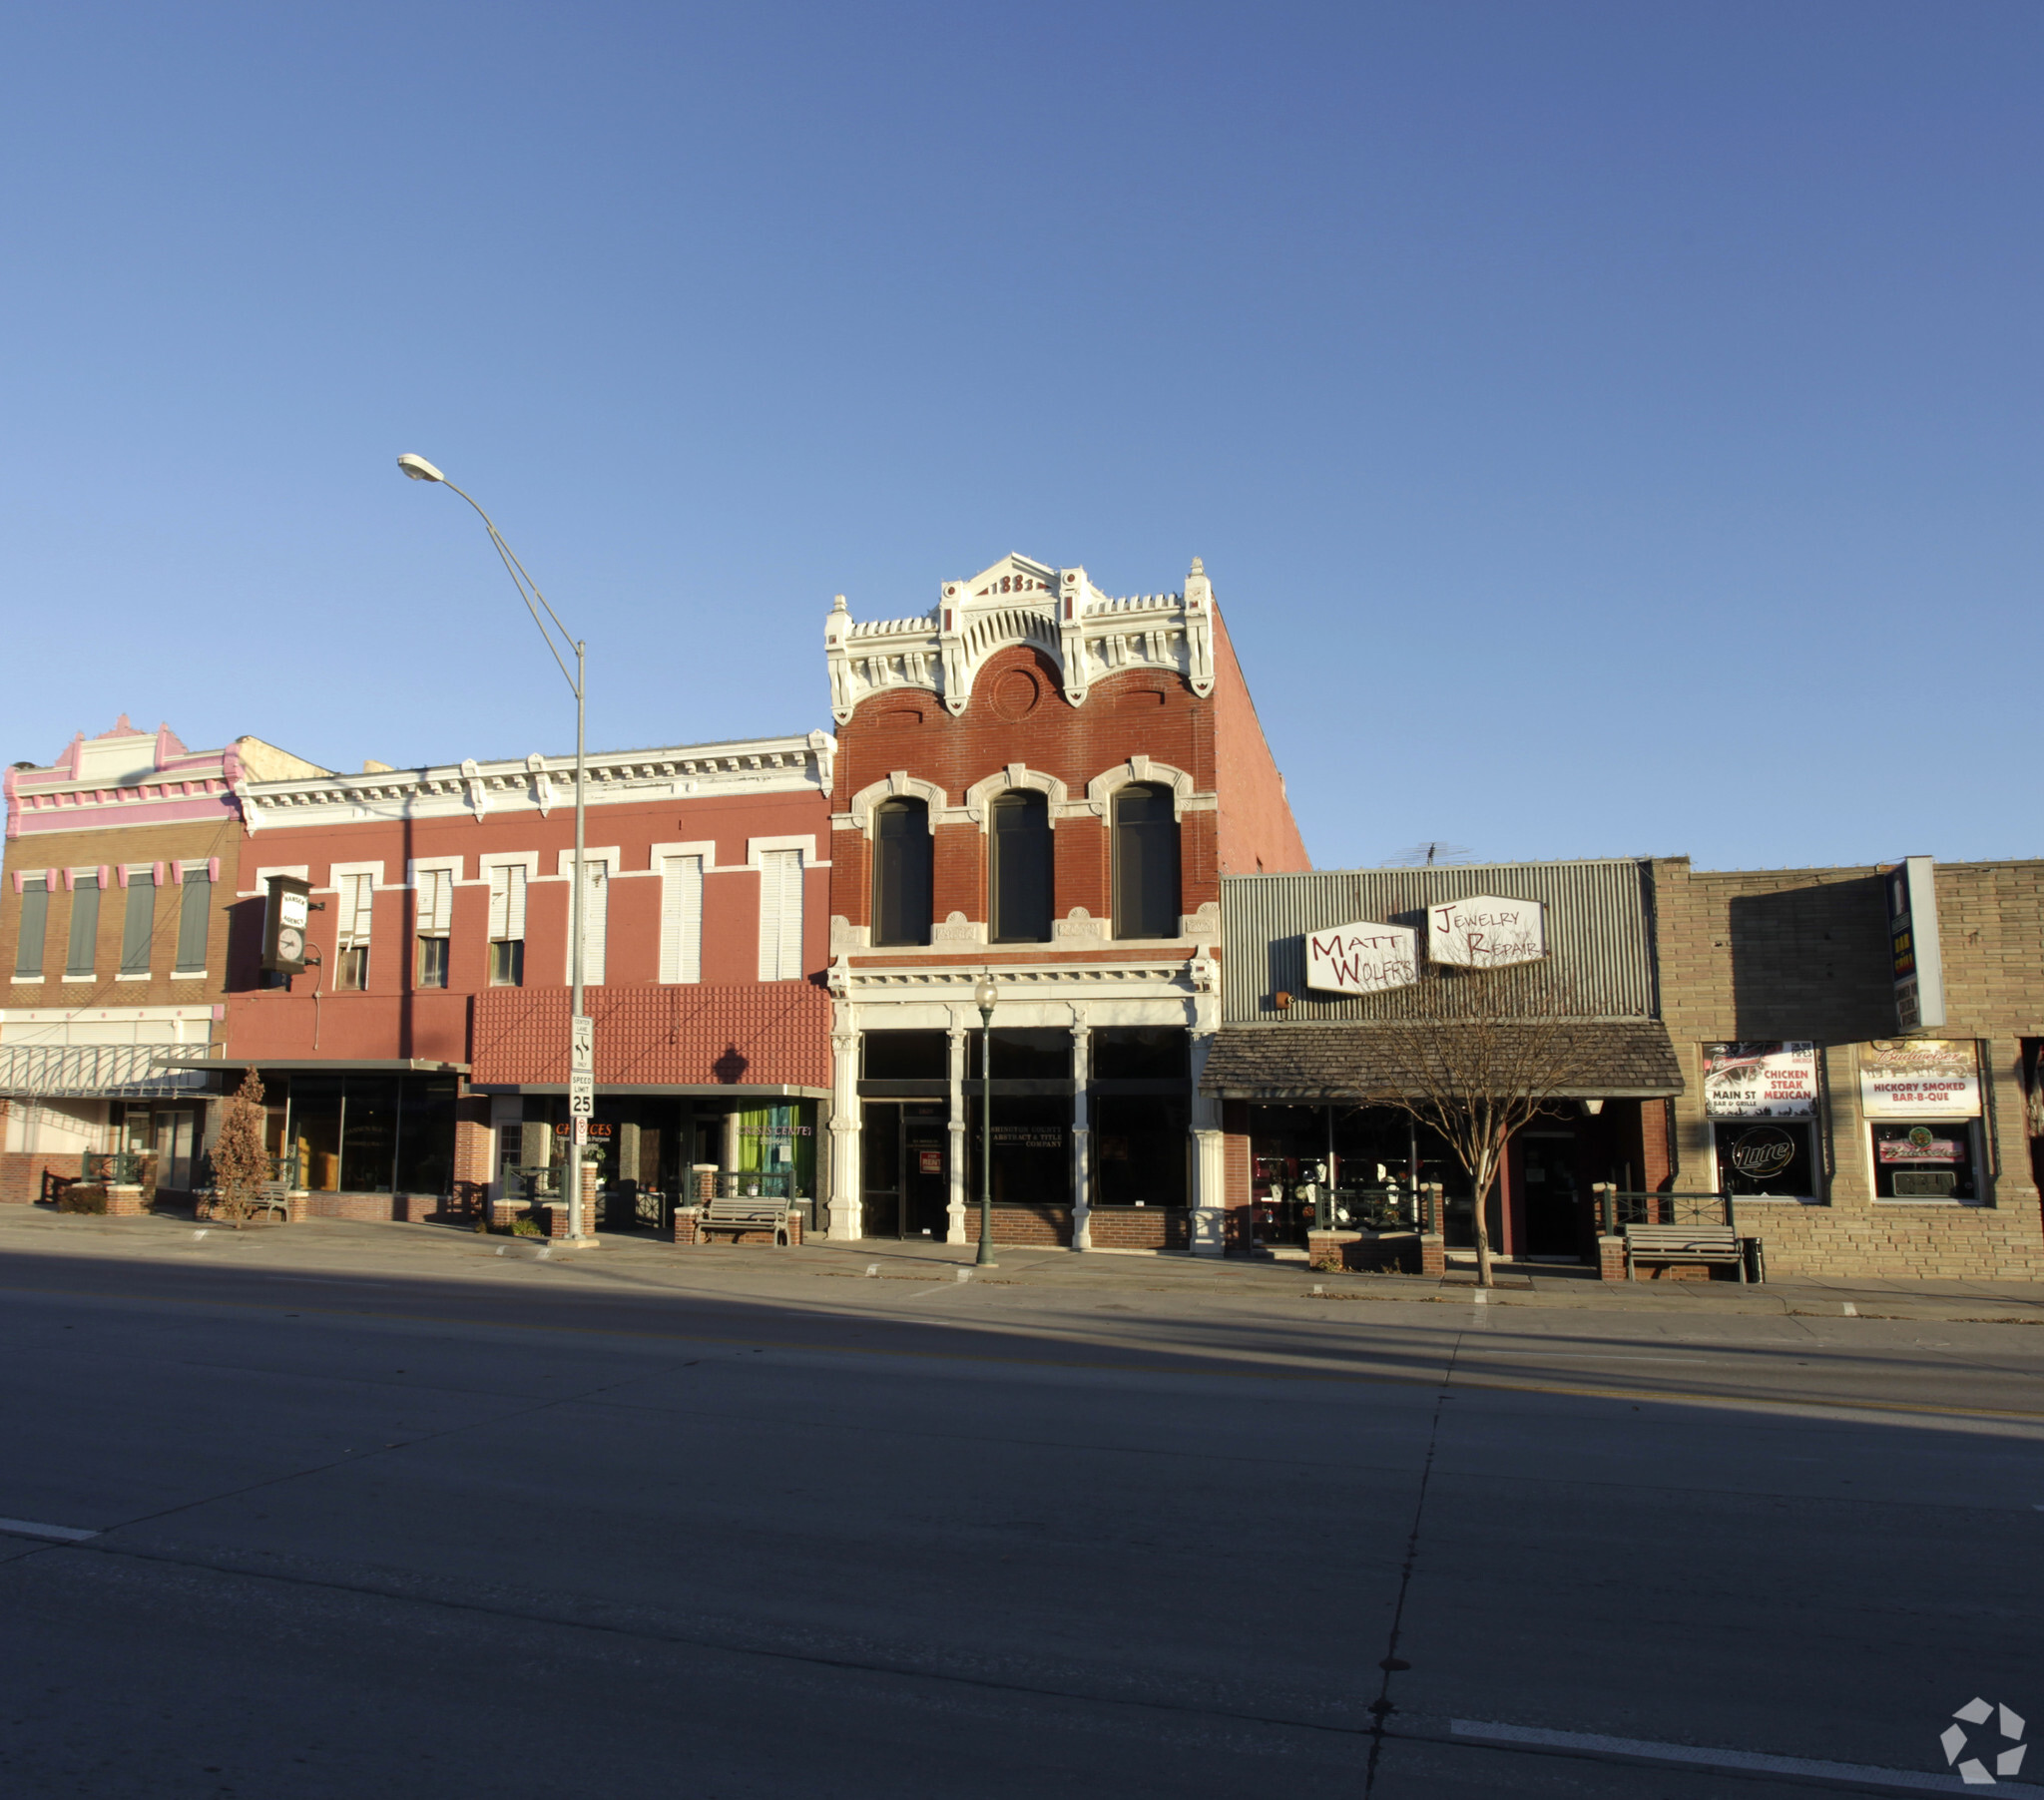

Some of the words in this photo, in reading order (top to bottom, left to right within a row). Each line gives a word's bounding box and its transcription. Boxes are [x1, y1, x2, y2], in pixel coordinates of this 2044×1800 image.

[991, 575, 1033, 594] 1883
[284, 896, 304, 905] HANSEN
[283, 915, 303, 925] AGENCY
[1435, 905, 1520, 933] JEWELRY
[1312, 935, 1402, 961] MATT
[1467, 933, 1540, 960] REPAIR
[1875, 1050, 1961, 1062] Budweiser
[1765, 1071, 1808, 1080] CHICKEN
[1771, 1081, 1803, 1090] STEAK
[1874, 1083, 1918, 1092] HICKORY
[1923, 1083, 1966, 1092] SMOKED
[1713, 1091, 1741, 1100] MAIN
[1746, 1091, 1757, 1100] ST
[1765, 1091, 1811, 1100] MEXICAN
[1892, 1093, 1949, 1102] BAR-B-QUE
[573, 1096, 591, 1113] 25
[556, 1124, 612, 1136] CHCES
